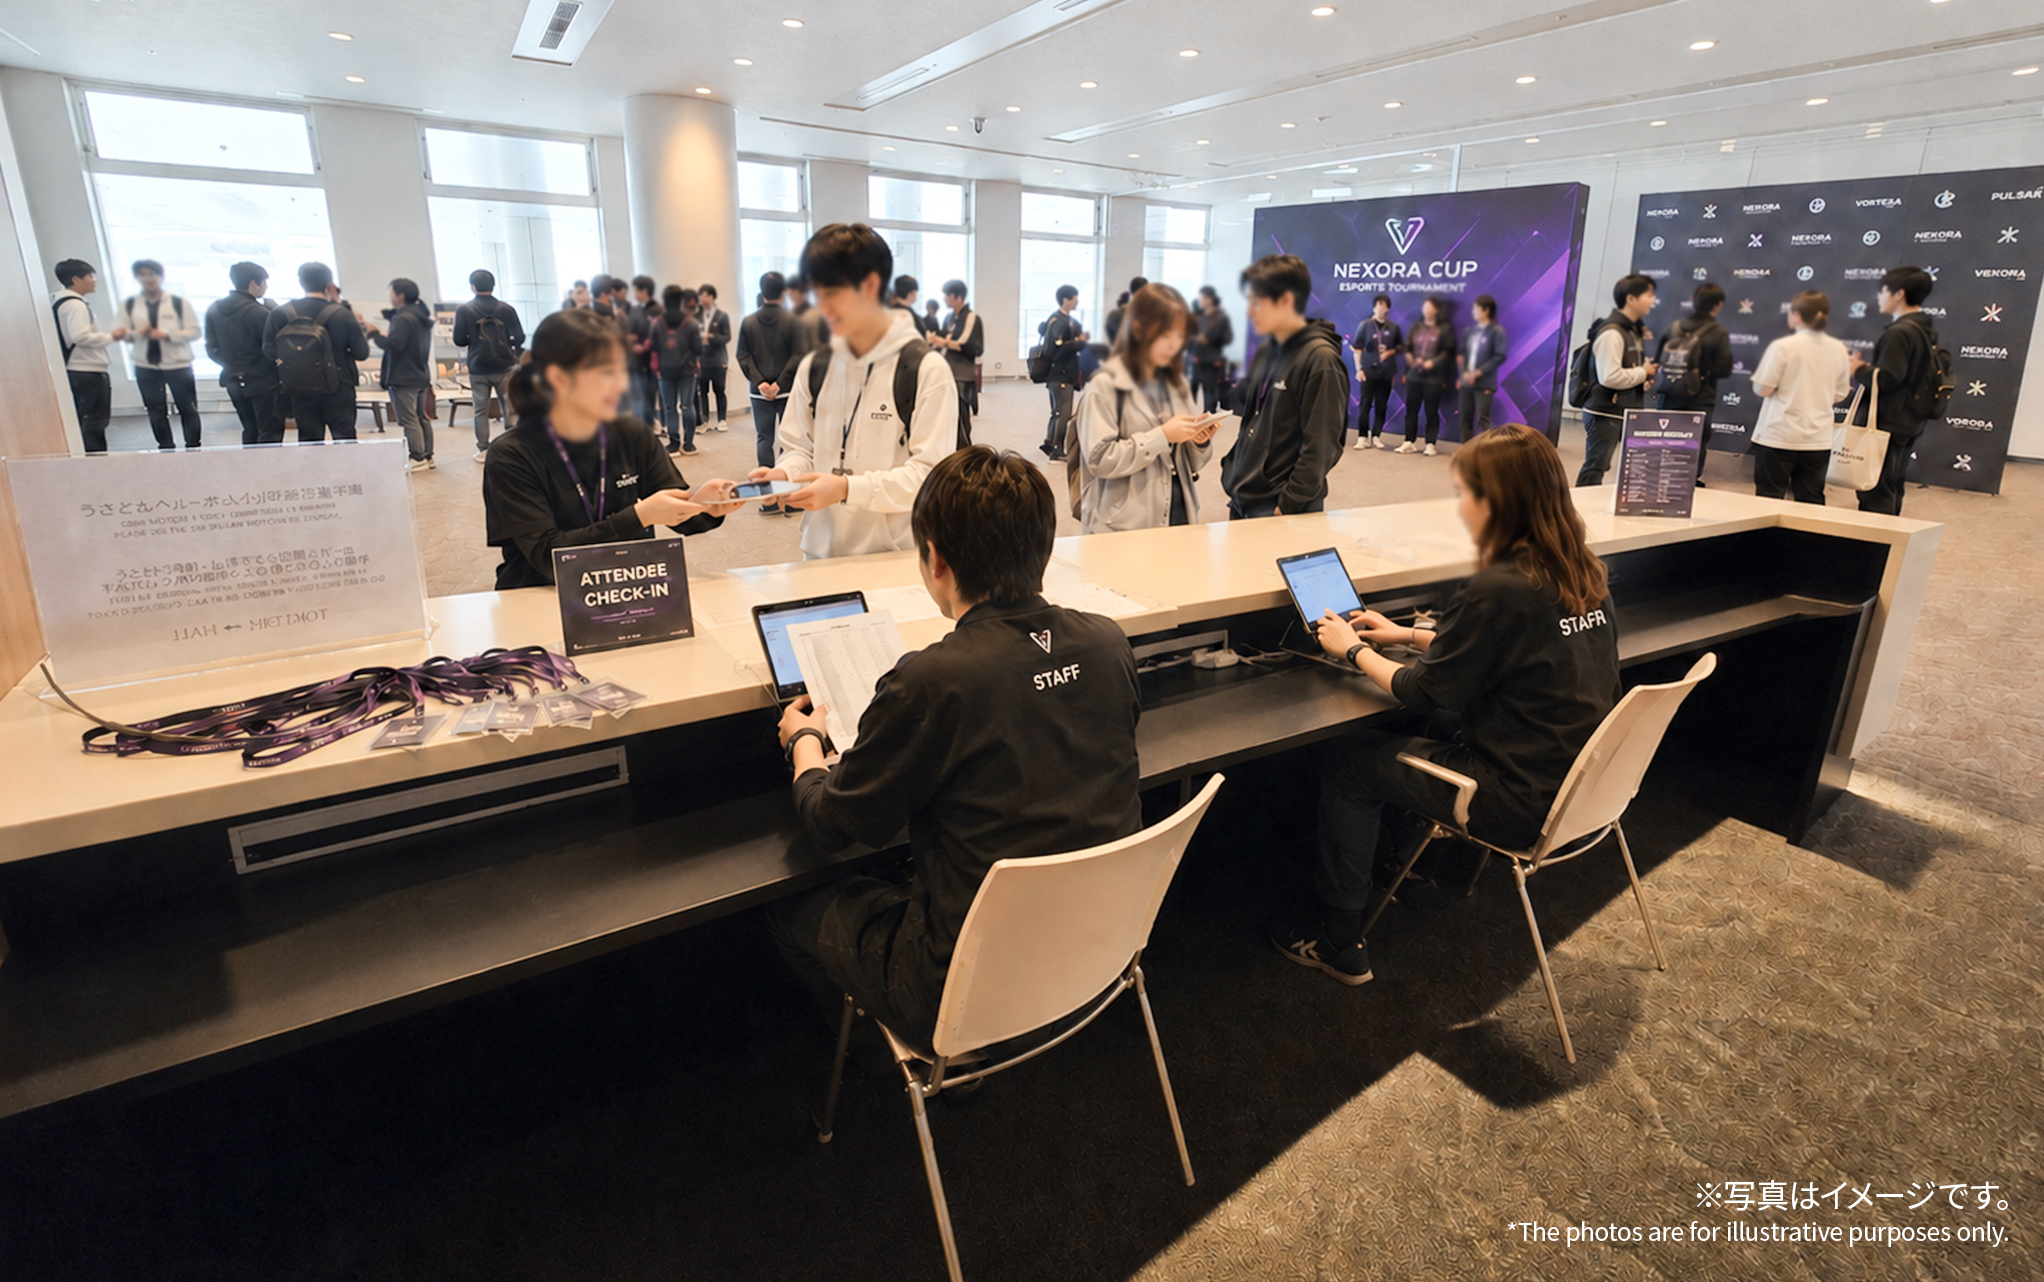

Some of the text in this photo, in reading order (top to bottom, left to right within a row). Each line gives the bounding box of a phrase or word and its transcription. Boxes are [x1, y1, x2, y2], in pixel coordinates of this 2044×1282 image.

[1333, 260, 1479, 279] NEXORA CUP
[580, 562, 668, 587] ATTENDEE
[584, 582, 670, 608] CHECK-IN
[1033, 663, 1080, 691] STAFF
